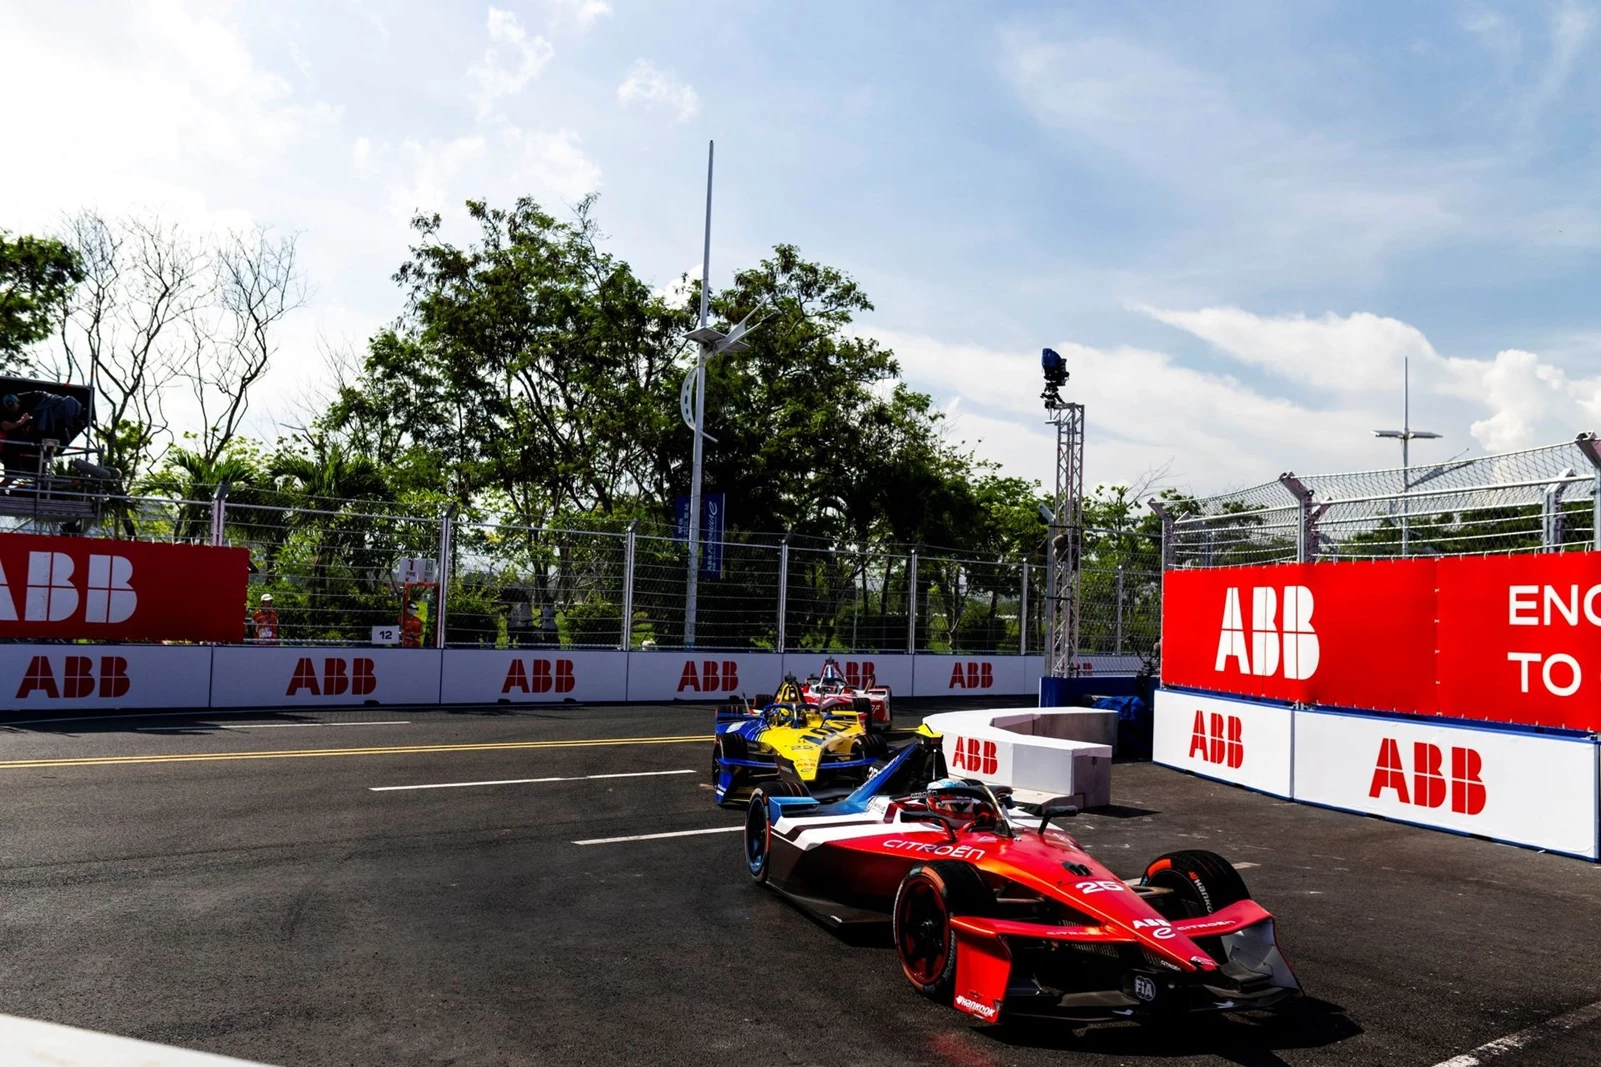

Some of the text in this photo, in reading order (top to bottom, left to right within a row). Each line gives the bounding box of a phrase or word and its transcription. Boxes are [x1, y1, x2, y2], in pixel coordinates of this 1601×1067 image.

[0, 551, 138, 624] BB
[379, 630, 392, 639] 12
[1214, 585, 1321, 681] ABB
[16, 656, 130, 698] ABB
[286, 658, 377, 695] ABB
[502, 659, 575, 693] ABB
[678, 661, 738, 692] ABB
[949, 662, 993, 688] ABB
[1507, 651, 1582, 697] TO
[952, 736, 998, 775] ABB
[1189, 710, 1244, 769] ABB
[1368, 738, 1487, 816] ABB
[1075, 880, 1125, 895] 25
[1132, 918, 1172, 929] ABB
